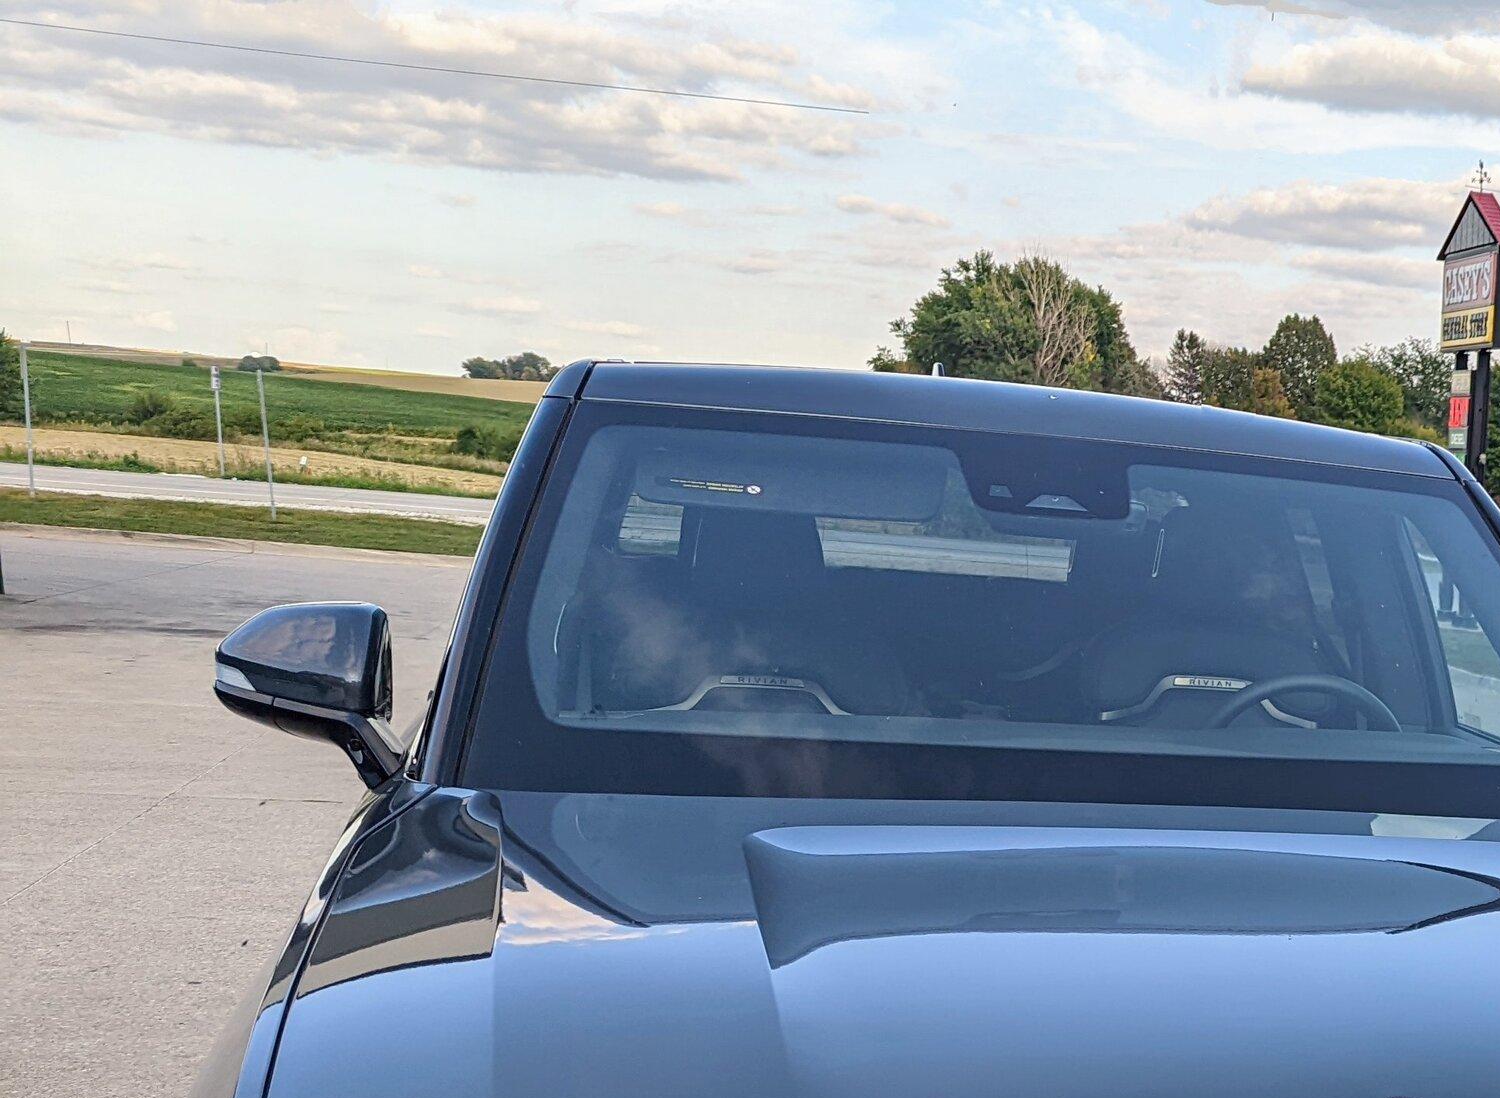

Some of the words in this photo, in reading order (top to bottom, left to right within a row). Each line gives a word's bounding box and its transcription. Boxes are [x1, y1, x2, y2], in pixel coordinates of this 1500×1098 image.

[1444, 260, 1491, 306] CASEY'S
[737, 676, 788, 685] RIVIAN
[1189, 679, 1232, 687] RIVIAN
